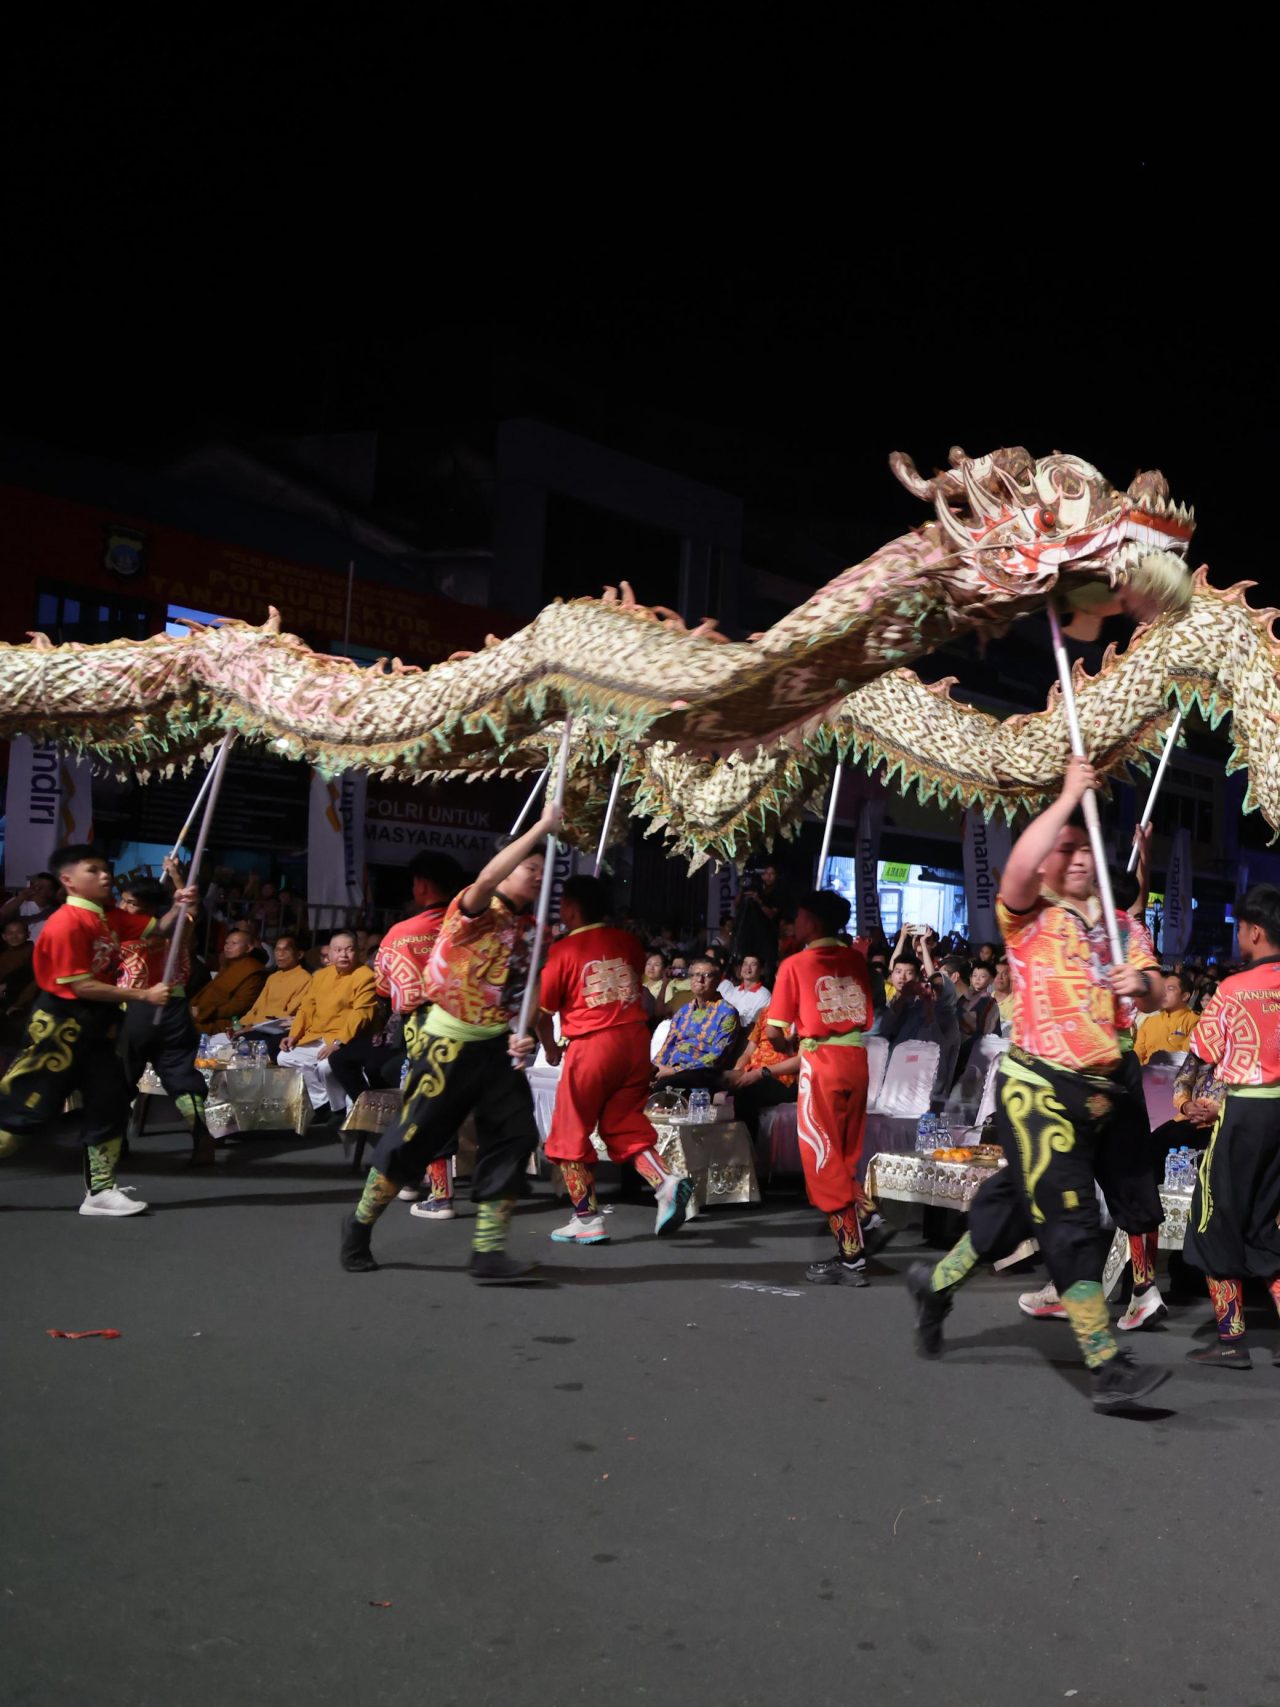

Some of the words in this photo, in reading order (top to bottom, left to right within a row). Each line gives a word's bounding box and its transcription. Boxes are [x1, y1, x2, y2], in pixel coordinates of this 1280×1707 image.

[364, 823, 489, 851] MASYARAKAT
[367, 797, 424, 820] POLRI
[428, 804, 491, 827] UNTUK
[861, 838, 880, 930] mandiri
[972, 824, 994, 909] mandiri
[1169, 857, 1182, 928] mandiri
